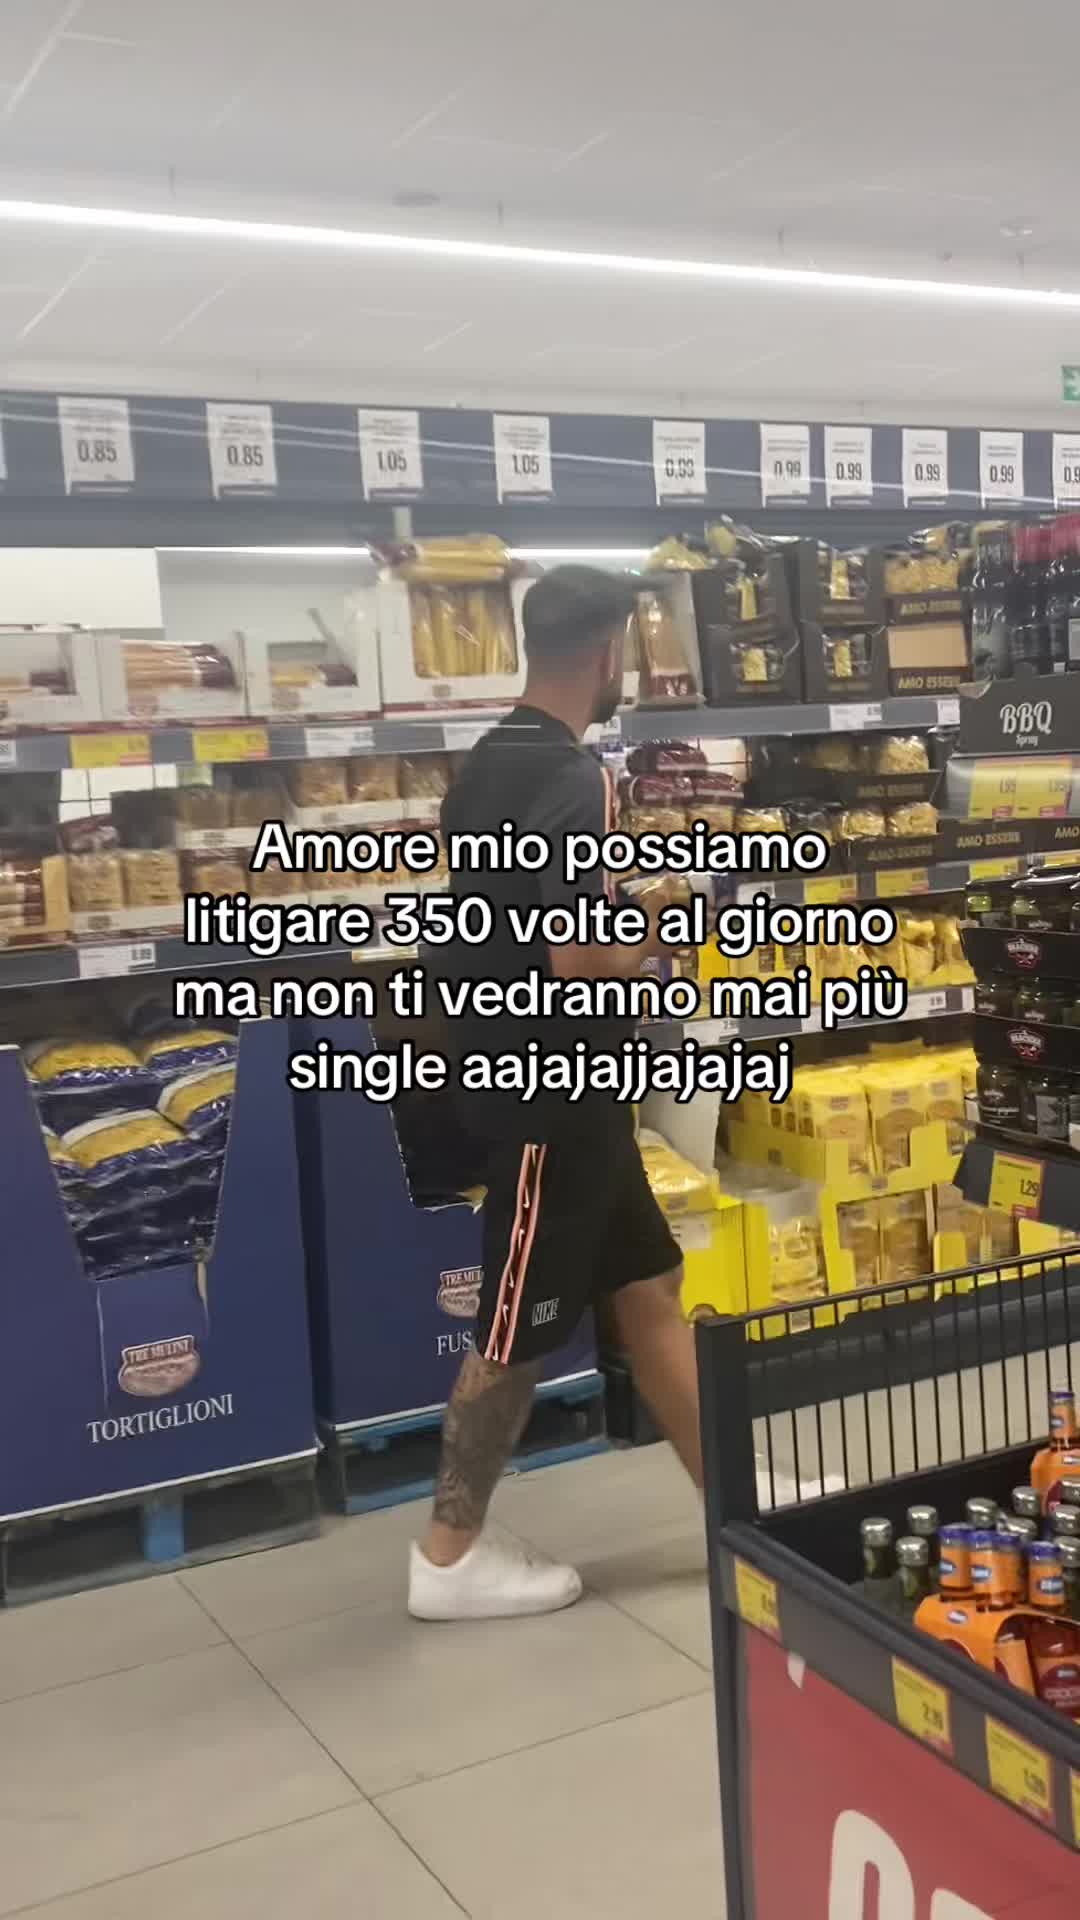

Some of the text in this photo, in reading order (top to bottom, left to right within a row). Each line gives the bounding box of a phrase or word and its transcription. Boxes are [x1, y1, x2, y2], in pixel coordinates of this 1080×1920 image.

[999, 700, 1053, 734] BBQ
[532, 1298, 560, 1326] NIKE
[86, 1394, 233, 1443] TORTIGLIONI
